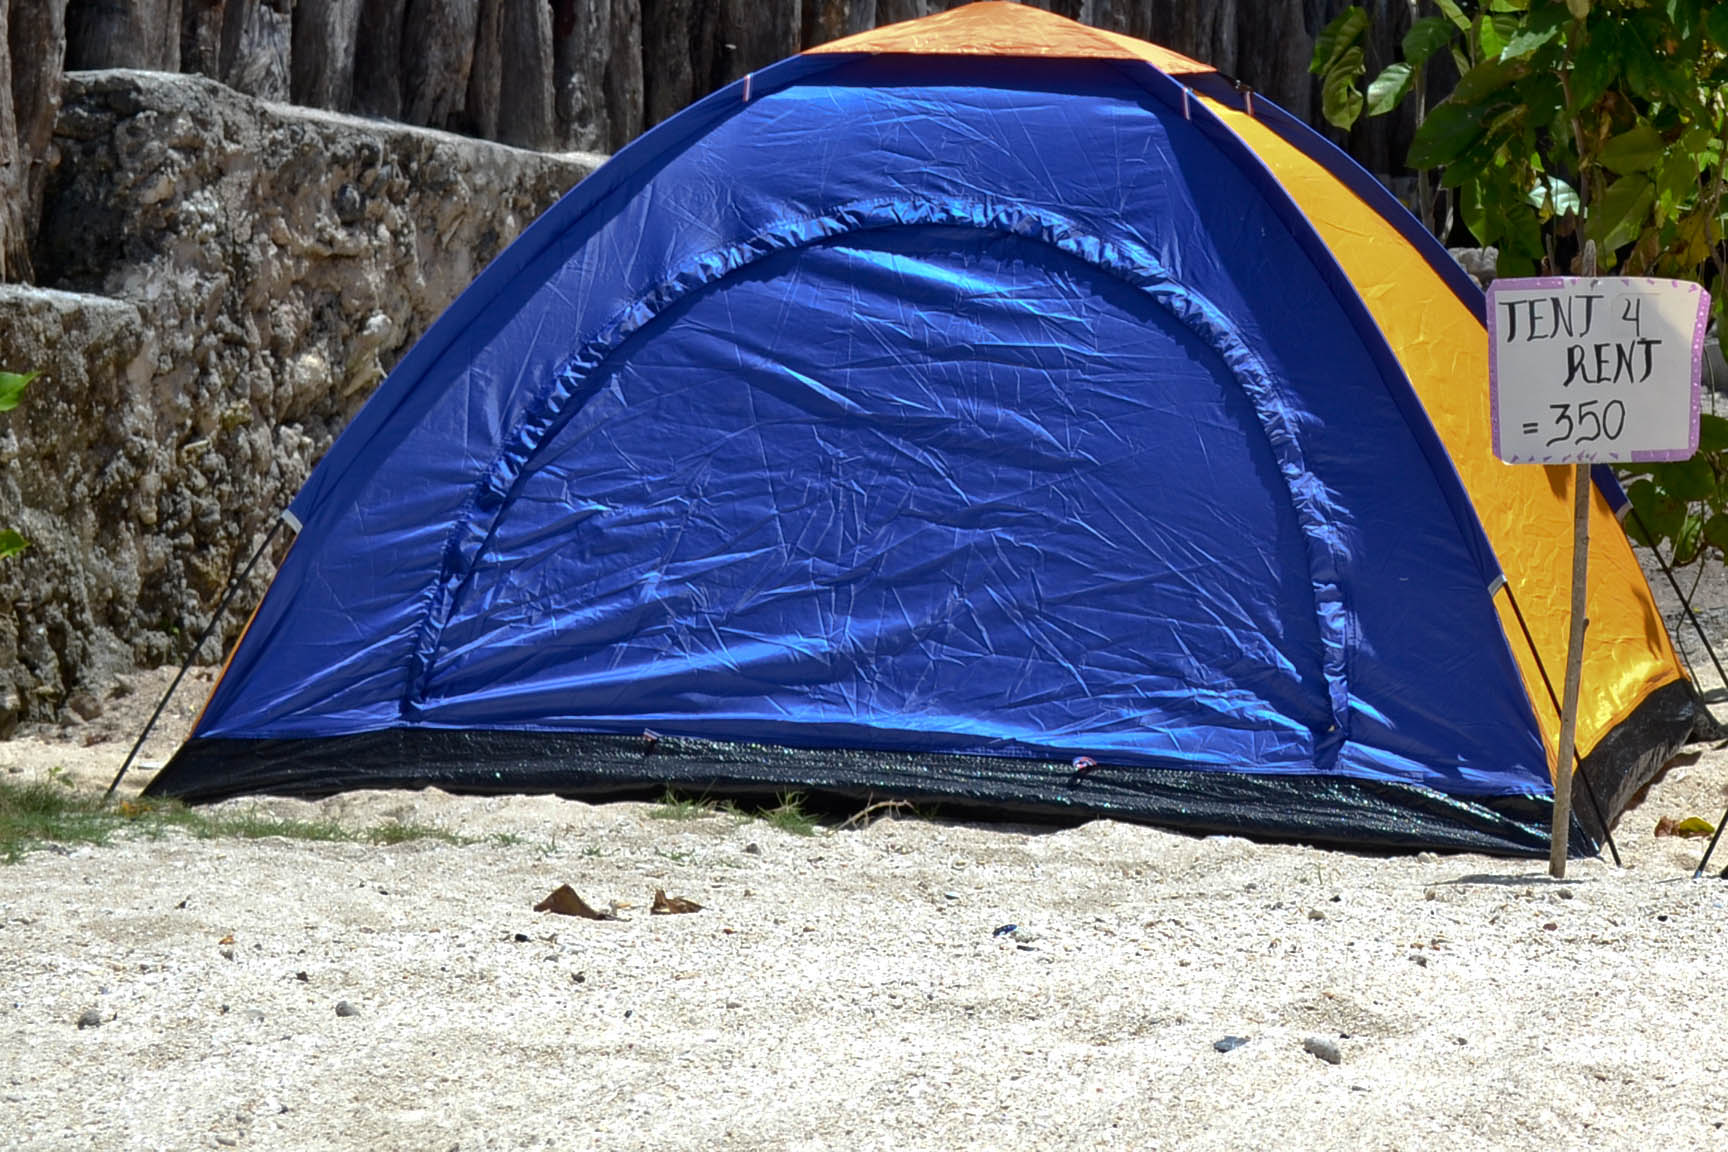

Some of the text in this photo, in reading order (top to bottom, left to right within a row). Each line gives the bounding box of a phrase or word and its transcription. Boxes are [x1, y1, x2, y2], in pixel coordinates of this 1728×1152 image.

[1498, 295, 1641, 343] TENT 4
[1563, 338, 1662, 387] RENT
